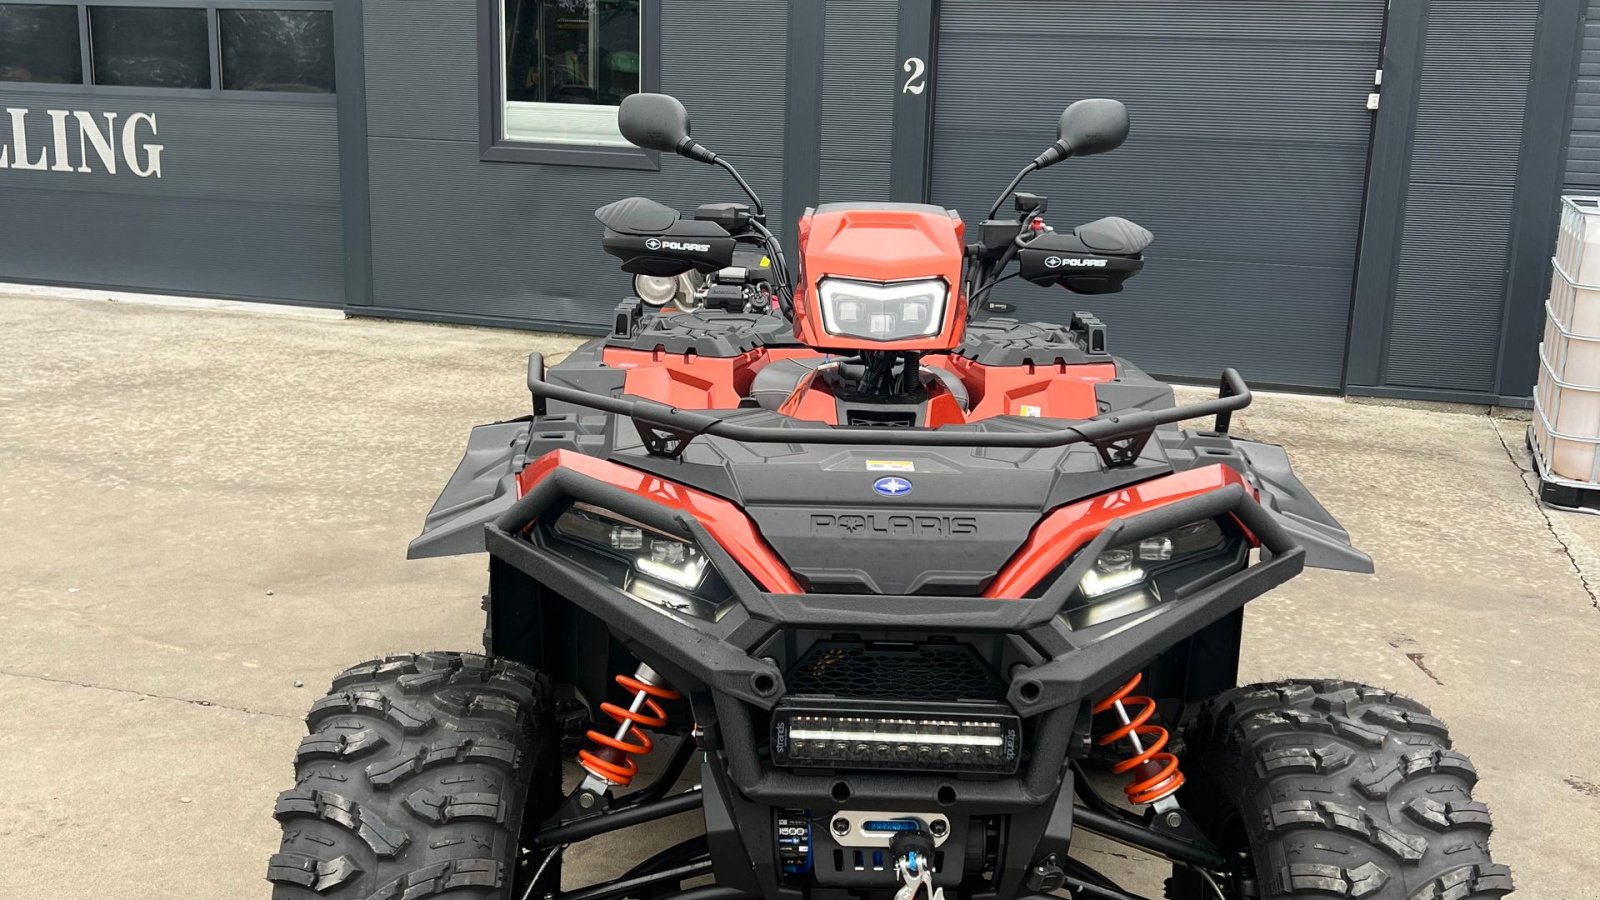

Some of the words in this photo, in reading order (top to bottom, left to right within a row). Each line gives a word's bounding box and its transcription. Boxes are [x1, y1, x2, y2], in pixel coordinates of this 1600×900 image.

[902, 57, 925, 95] 2
[0, 108, 164, 178] LING
[662, 241, 711, 252] POLARIS
[1062, 258, 1108, 267] POLARIS
[810, 514, 978, 536] POLARIS
[775, 722, 785, 753] strands
[1006, 729, 1016, 760] strands
